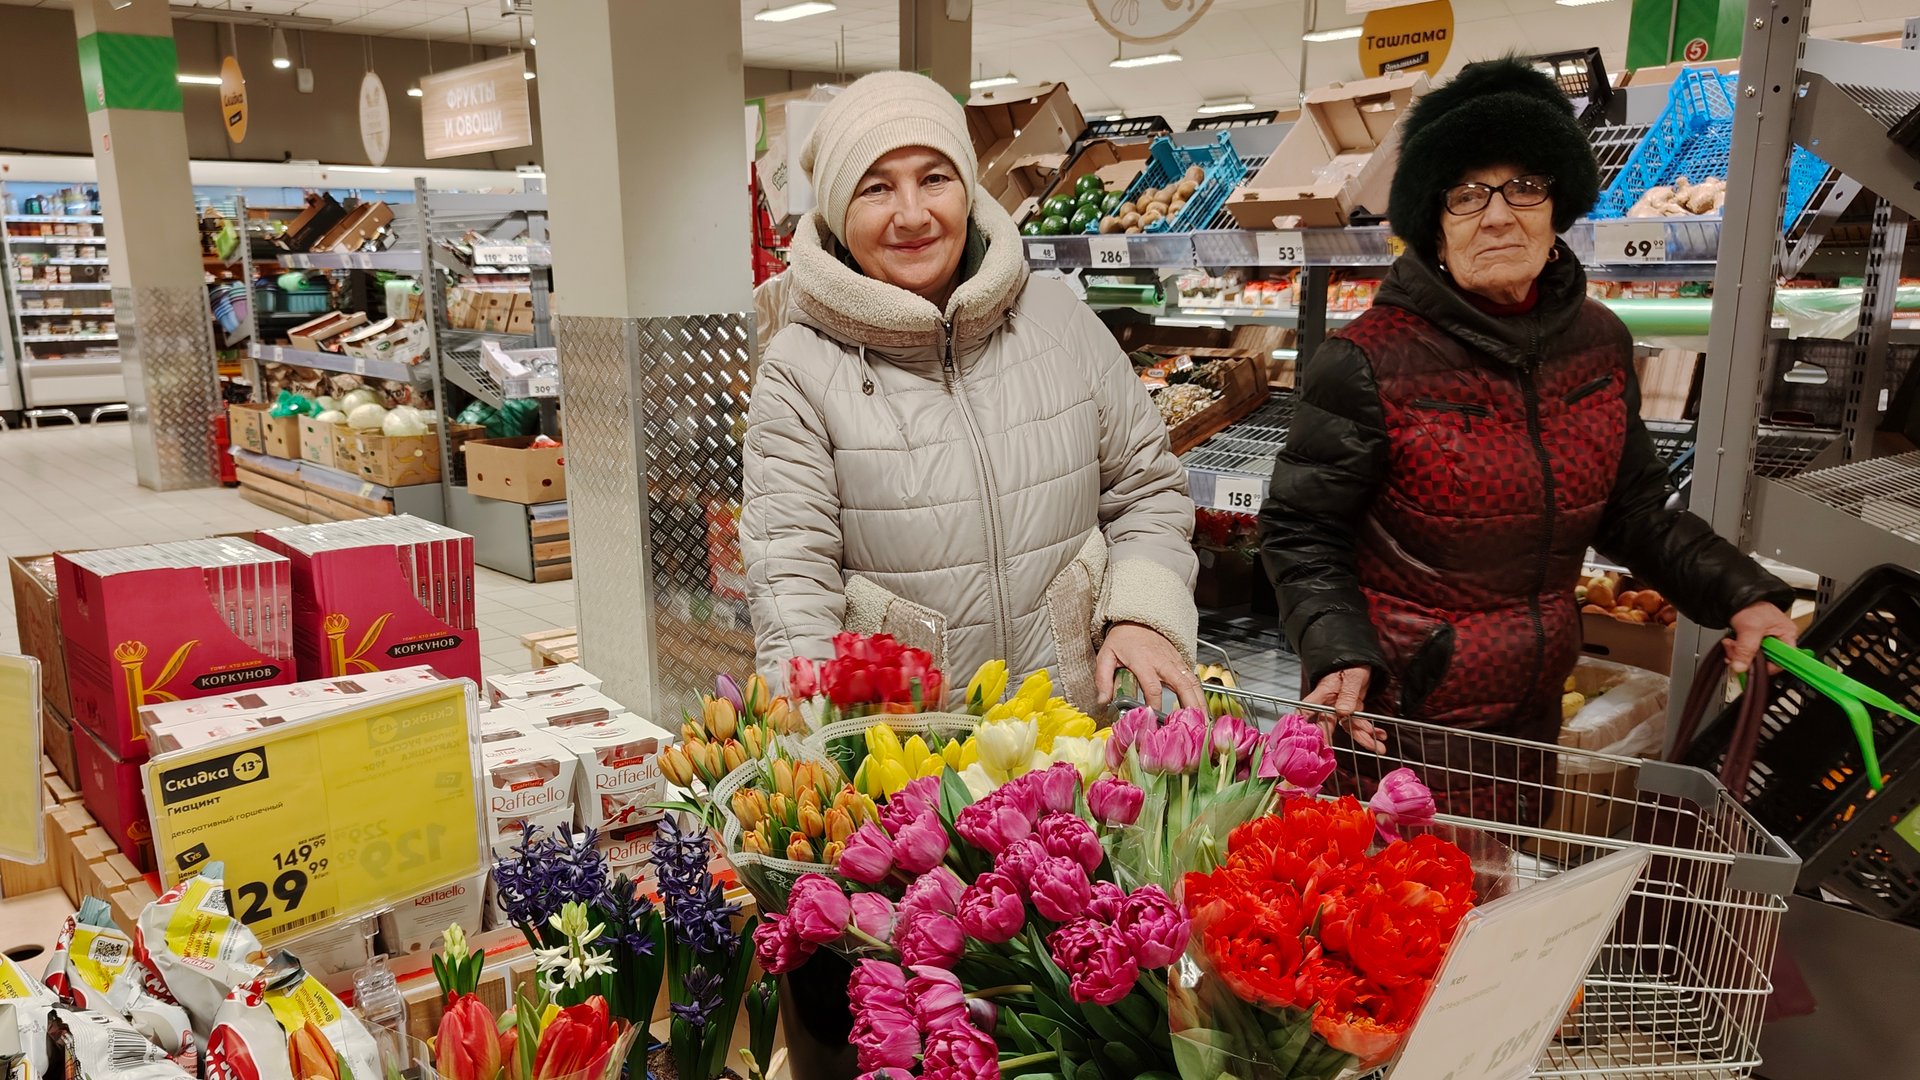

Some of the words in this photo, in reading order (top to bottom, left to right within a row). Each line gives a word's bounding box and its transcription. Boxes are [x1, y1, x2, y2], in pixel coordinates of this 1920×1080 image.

[1366, 28, 1447, 50] Ташлама
[447, 80, 496, 109] ФРУКТЫ
[444, 119, 454, 138] И
[456, 110, 502, 136] ОВОЩИ
[1100, 251, 1122, 263] 286
[1278, 247, 1295, 260] 53
[1624, 240, 1652, 257] 69
[1228, 491, 1252, 507] 158
[394, 638, 455, 655] КОРКУНОВ
[202, 668, 272, 687] КОРКУНОВ
[165, 767, 229, 792] Скидка
[235, 759, 262, 773] -13%
[596, 765, 662, 789] Raffaello
[167, 796, 221, 816] Гиацинт
[491, 787, 565, 813] Raffaello
[171, 816, 234, 839] декоративный
[236, 802, 283, 821] горшечный
[272, 844, 313, 871] 149
[313, 838, 326, 849] 99
[608, 840, 654, 862] Raffae
[308, 858, 329, 874] 99
[415, 885, 466, 907] Raffaello
